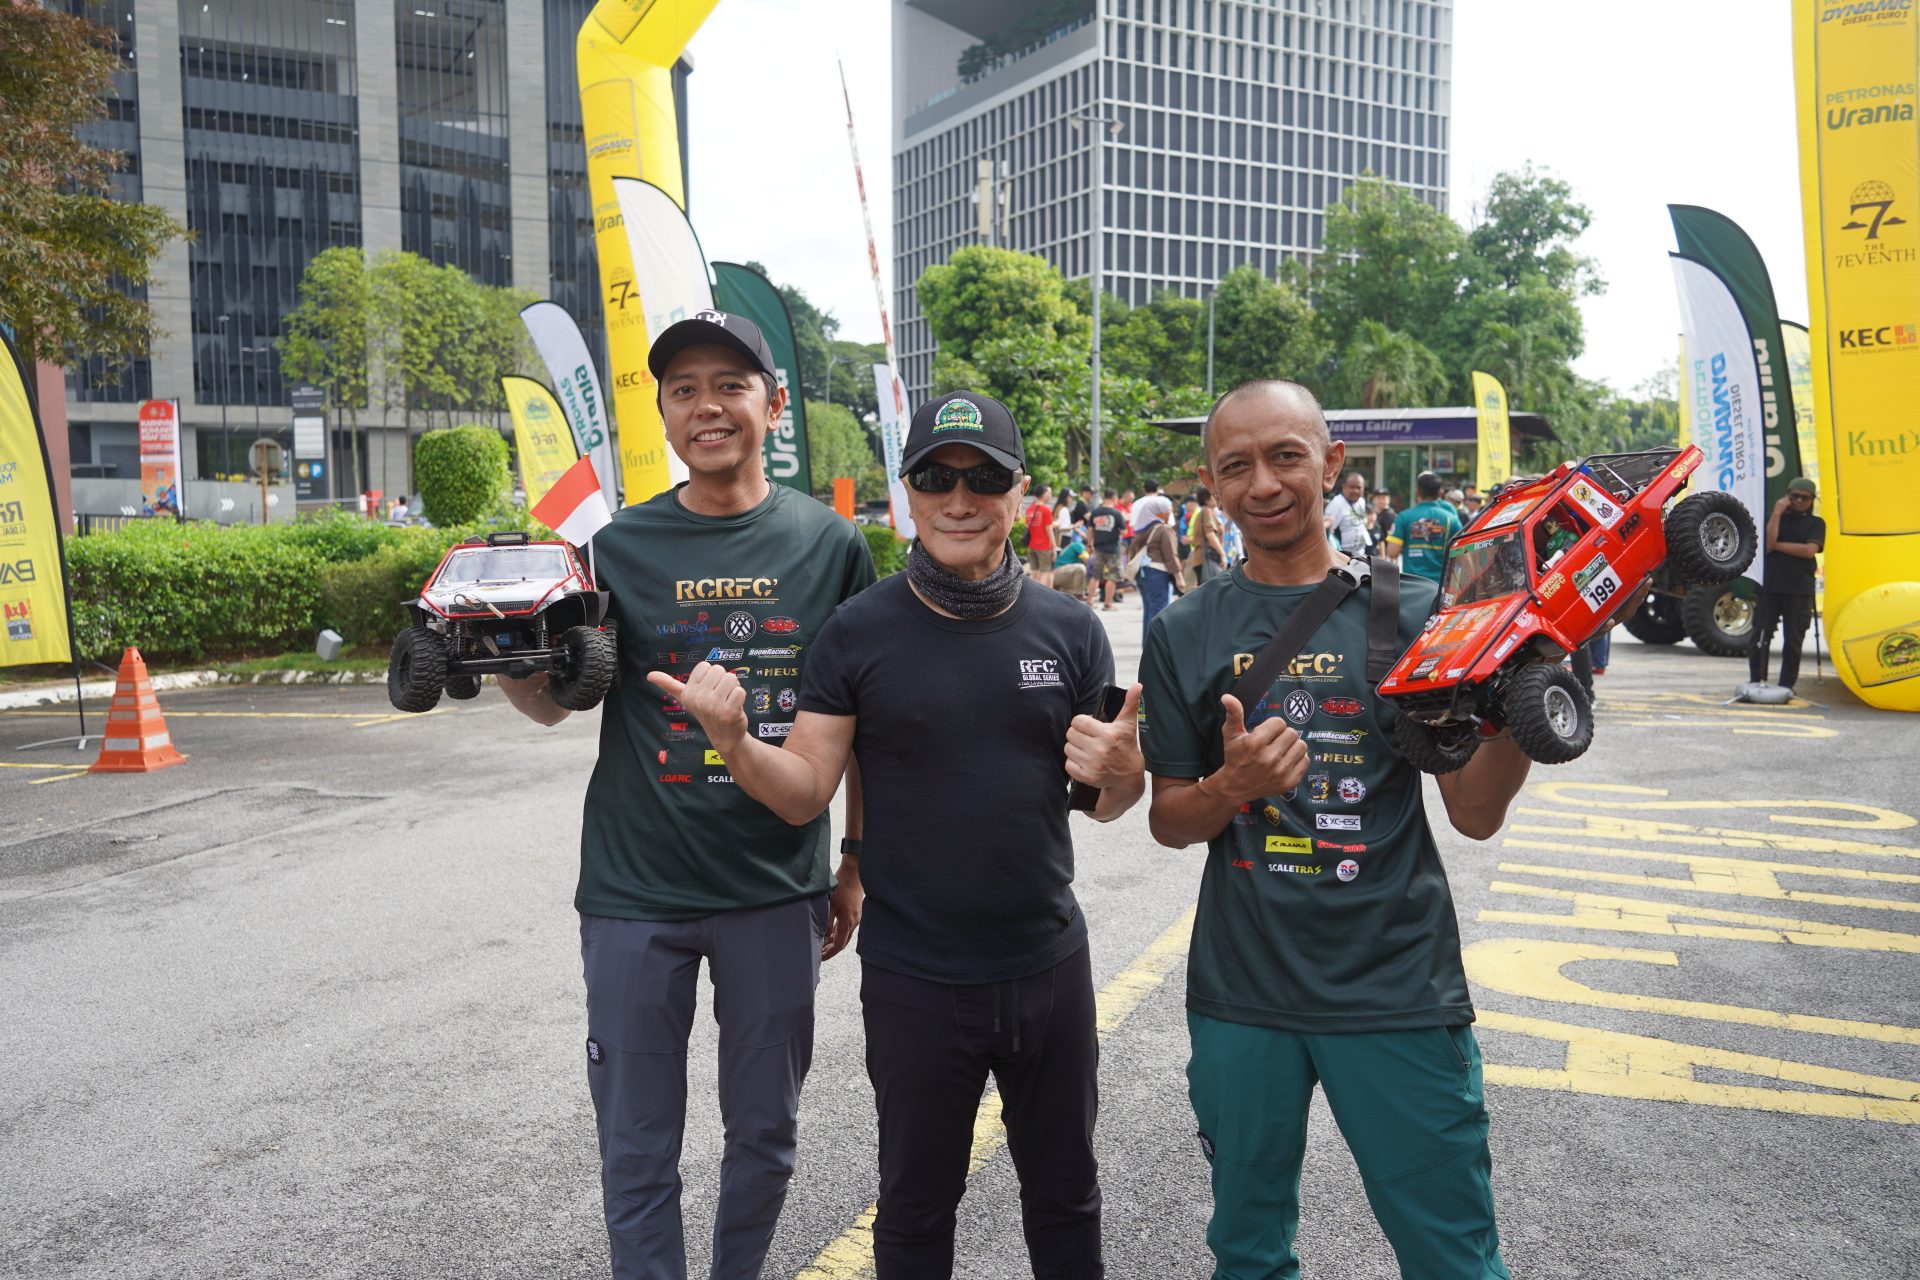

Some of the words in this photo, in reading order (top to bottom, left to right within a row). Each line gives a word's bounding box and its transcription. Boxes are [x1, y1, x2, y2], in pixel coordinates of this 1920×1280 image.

[1822, 0, 1911, 22] DYNAMIC
[1842, 14, 1873, 26] DIESEL
[1876, 11, 1901, 20] EURO
[1826, 83, 1914, 105] PETRONAS
[1827, 99, 1914, 130] Urania
[1864, 242, 1884, 251] THE
[1835, 248, 1916, 268] 7EVENTH
[1839, 326, 1891, 349] KEC
[615, 371, 639, 389] KEC
[574, 364, 604, 449] Urania
[1366, 421, 1413, 433] Gallery
[1589, 577, 1616, 607] 199
[1323, 753, 1365, 764] MEUS
[1331, 817, 1360, 827] XC-ESC
